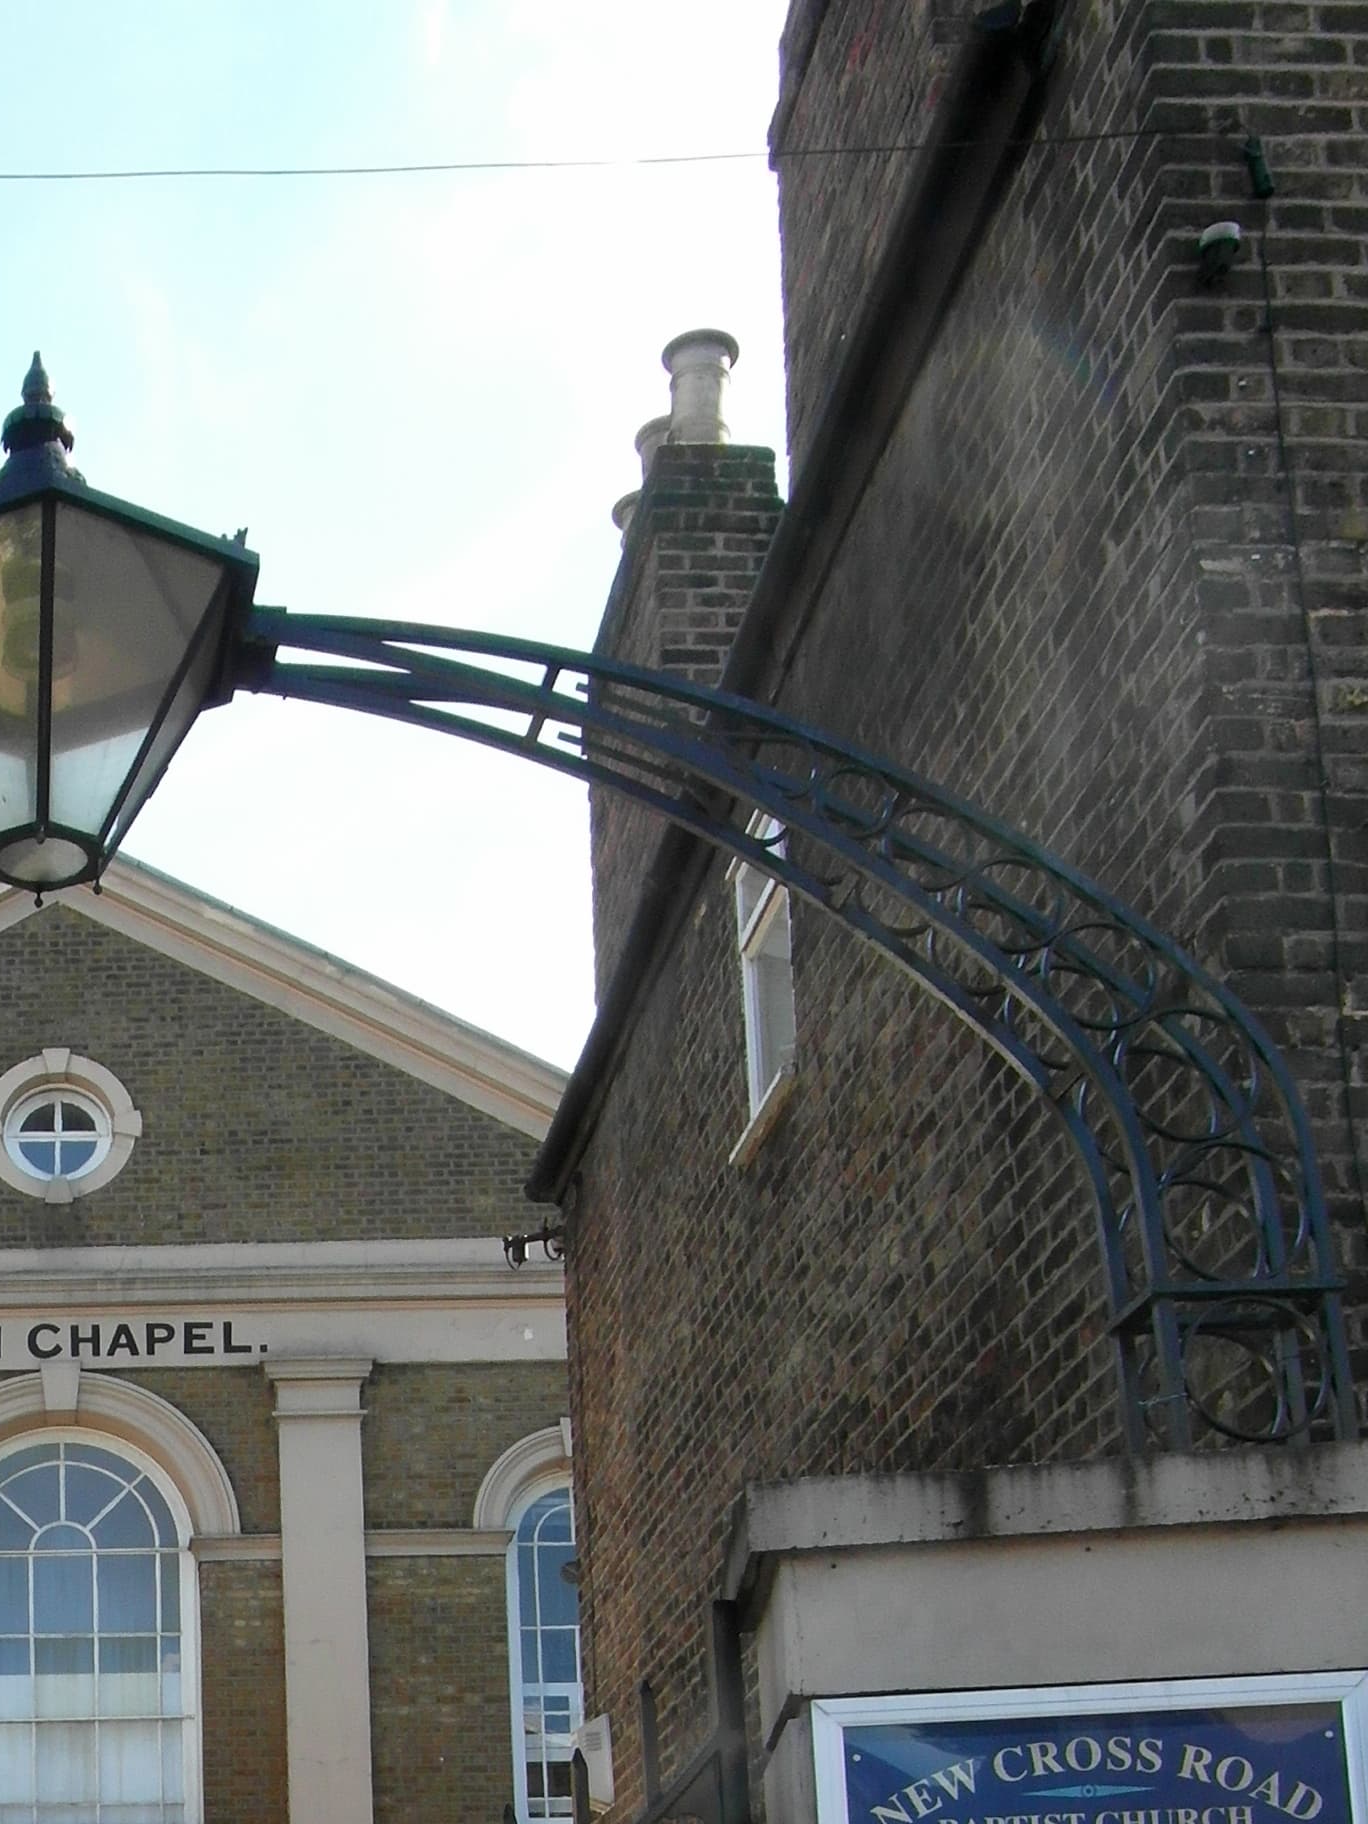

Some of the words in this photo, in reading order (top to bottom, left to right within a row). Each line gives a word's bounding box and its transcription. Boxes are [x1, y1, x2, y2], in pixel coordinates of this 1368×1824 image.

[27, 1321, 269, 1359] CHAPEL.
[992, 1736, 1164, 1783] CROSS
[1178, 1743, 1324, 1821] ROAD
